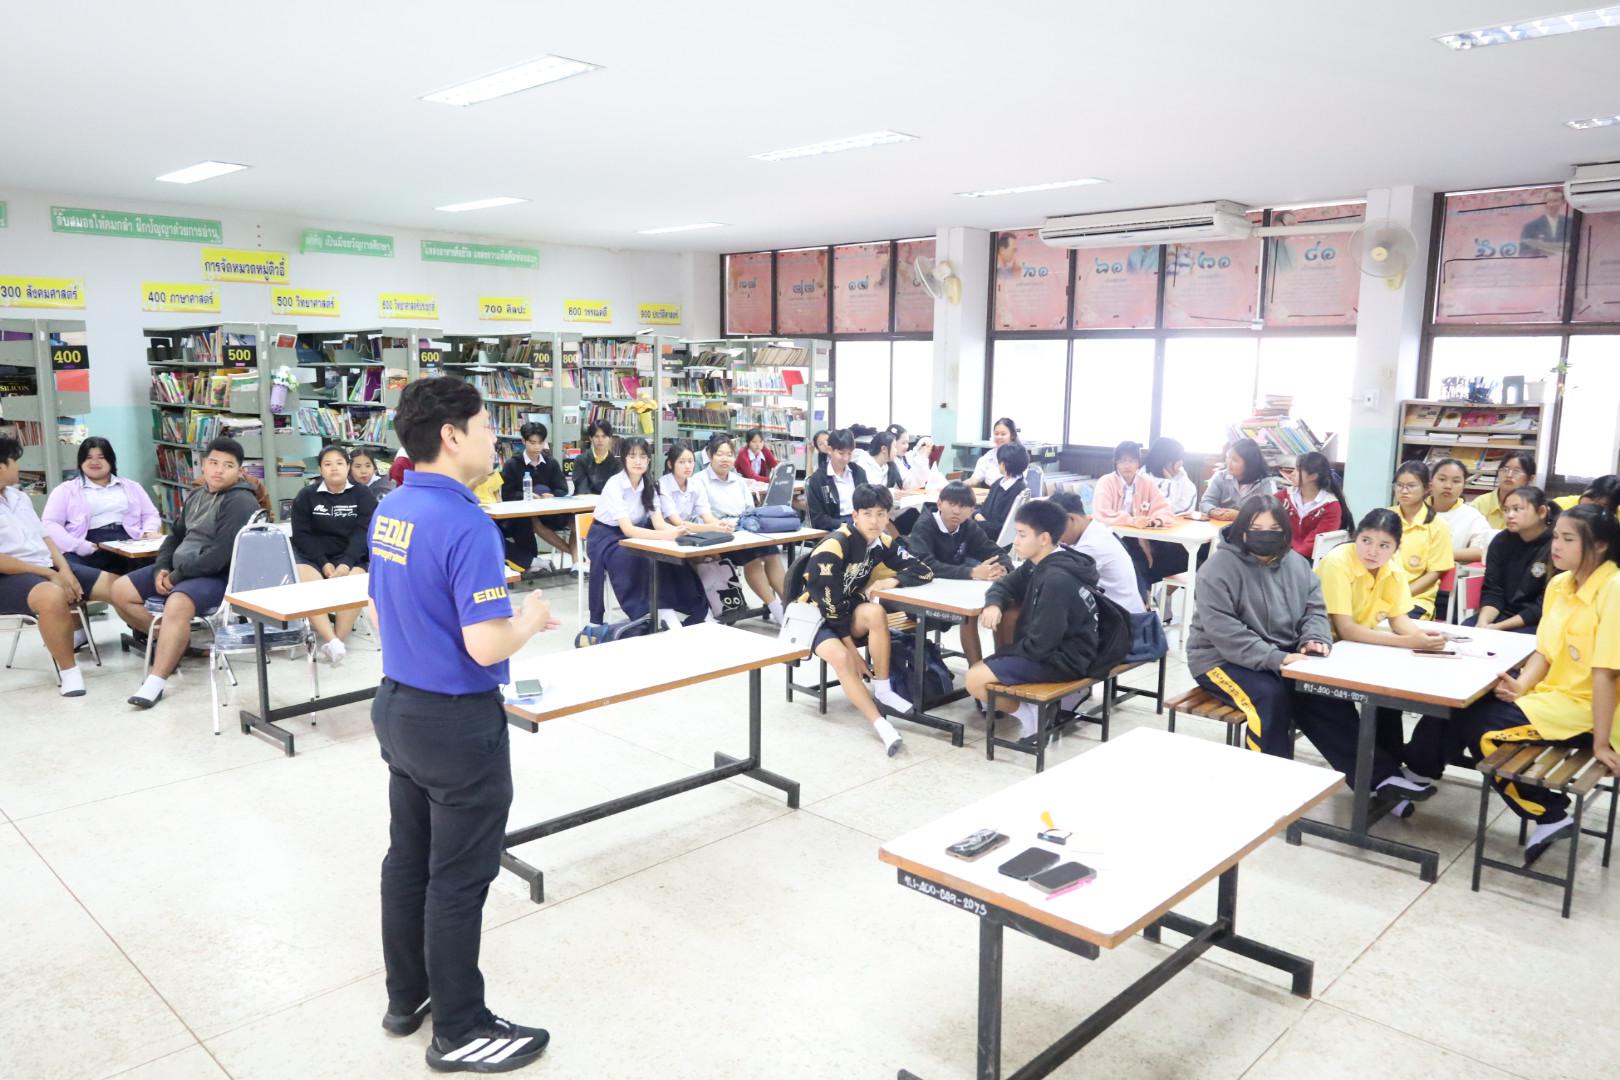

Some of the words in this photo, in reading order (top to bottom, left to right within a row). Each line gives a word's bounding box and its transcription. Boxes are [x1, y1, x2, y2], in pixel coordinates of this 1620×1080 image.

[204, 257, 285, 281] การจัดหมวดหมู่ดิวอี้
[0, 286, 22, 298] 300
[26, 284, 78, 300] สังคมศาสตร์
[148, 292, 166, 303] 400
[277, 296, 293, 307] 500
[484, 304, 502, 313] 700
[506, 303, 526, 314] ศิลปะ
[568, 306, 581, 316] 800
[54, 350, 81, 363] 400
[228, 349, 251, 361] 500
[421, 351, 440, 362] 600
[533, 352, 550, 363] 700
[563, 353, 578, 364] 800
[373, 515, 414, 549] EDU
[473, 586, 507, 604] EDU
